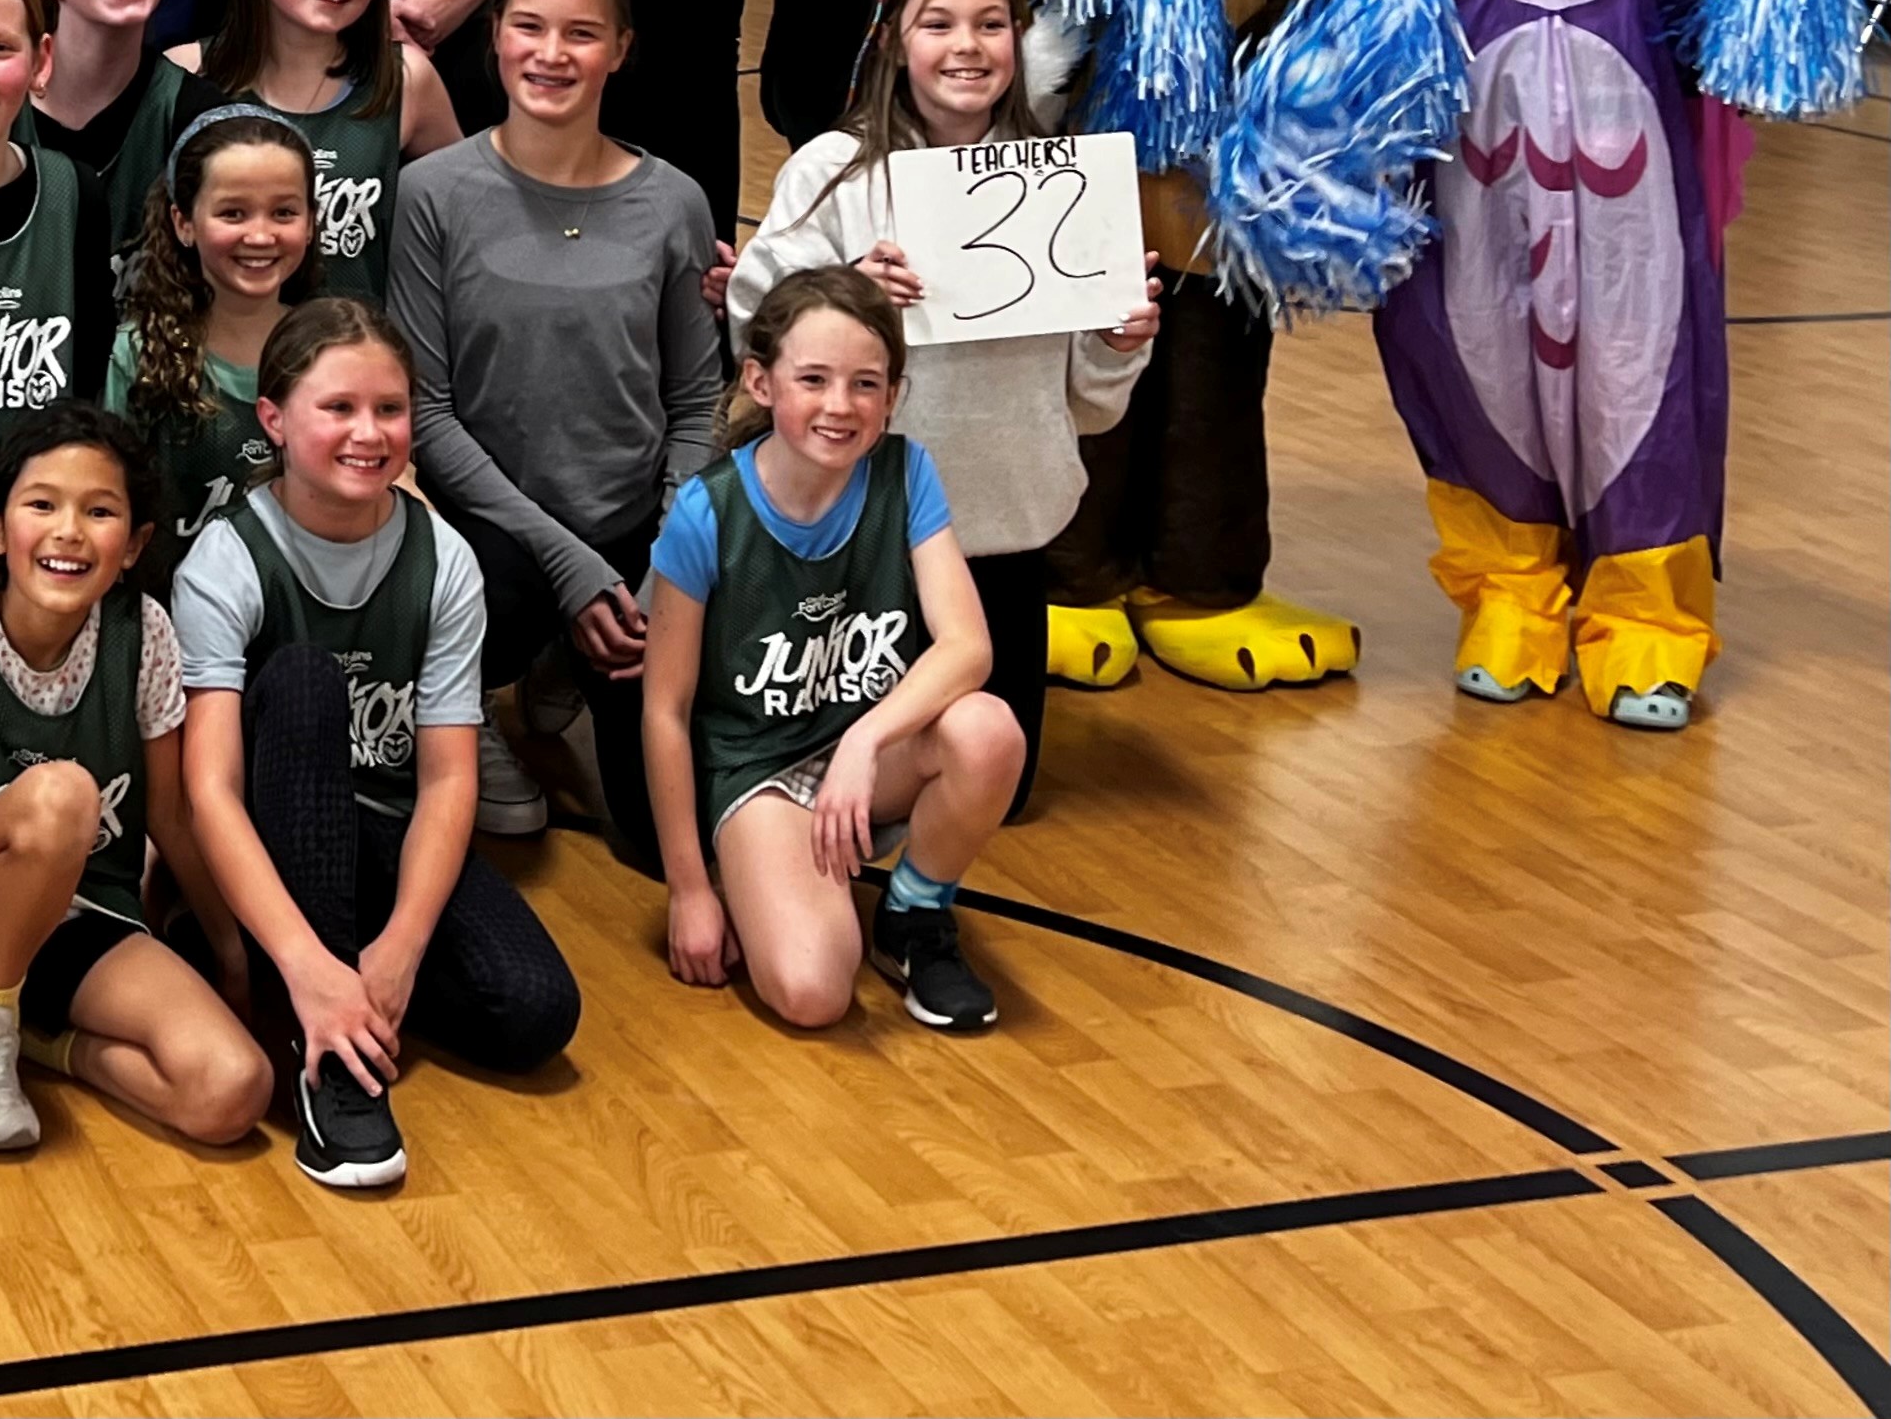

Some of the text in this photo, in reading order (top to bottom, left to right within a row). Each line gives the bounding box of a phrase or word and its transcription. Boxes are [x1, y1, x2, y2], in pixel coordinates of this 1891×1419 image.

[950, 137, 1077, 174] TEACHERS!
[953, 169, 1106, 320] 32
[734, 610, 908, 695] JUNIOR
[764, 673, 861, 716] RAMS
